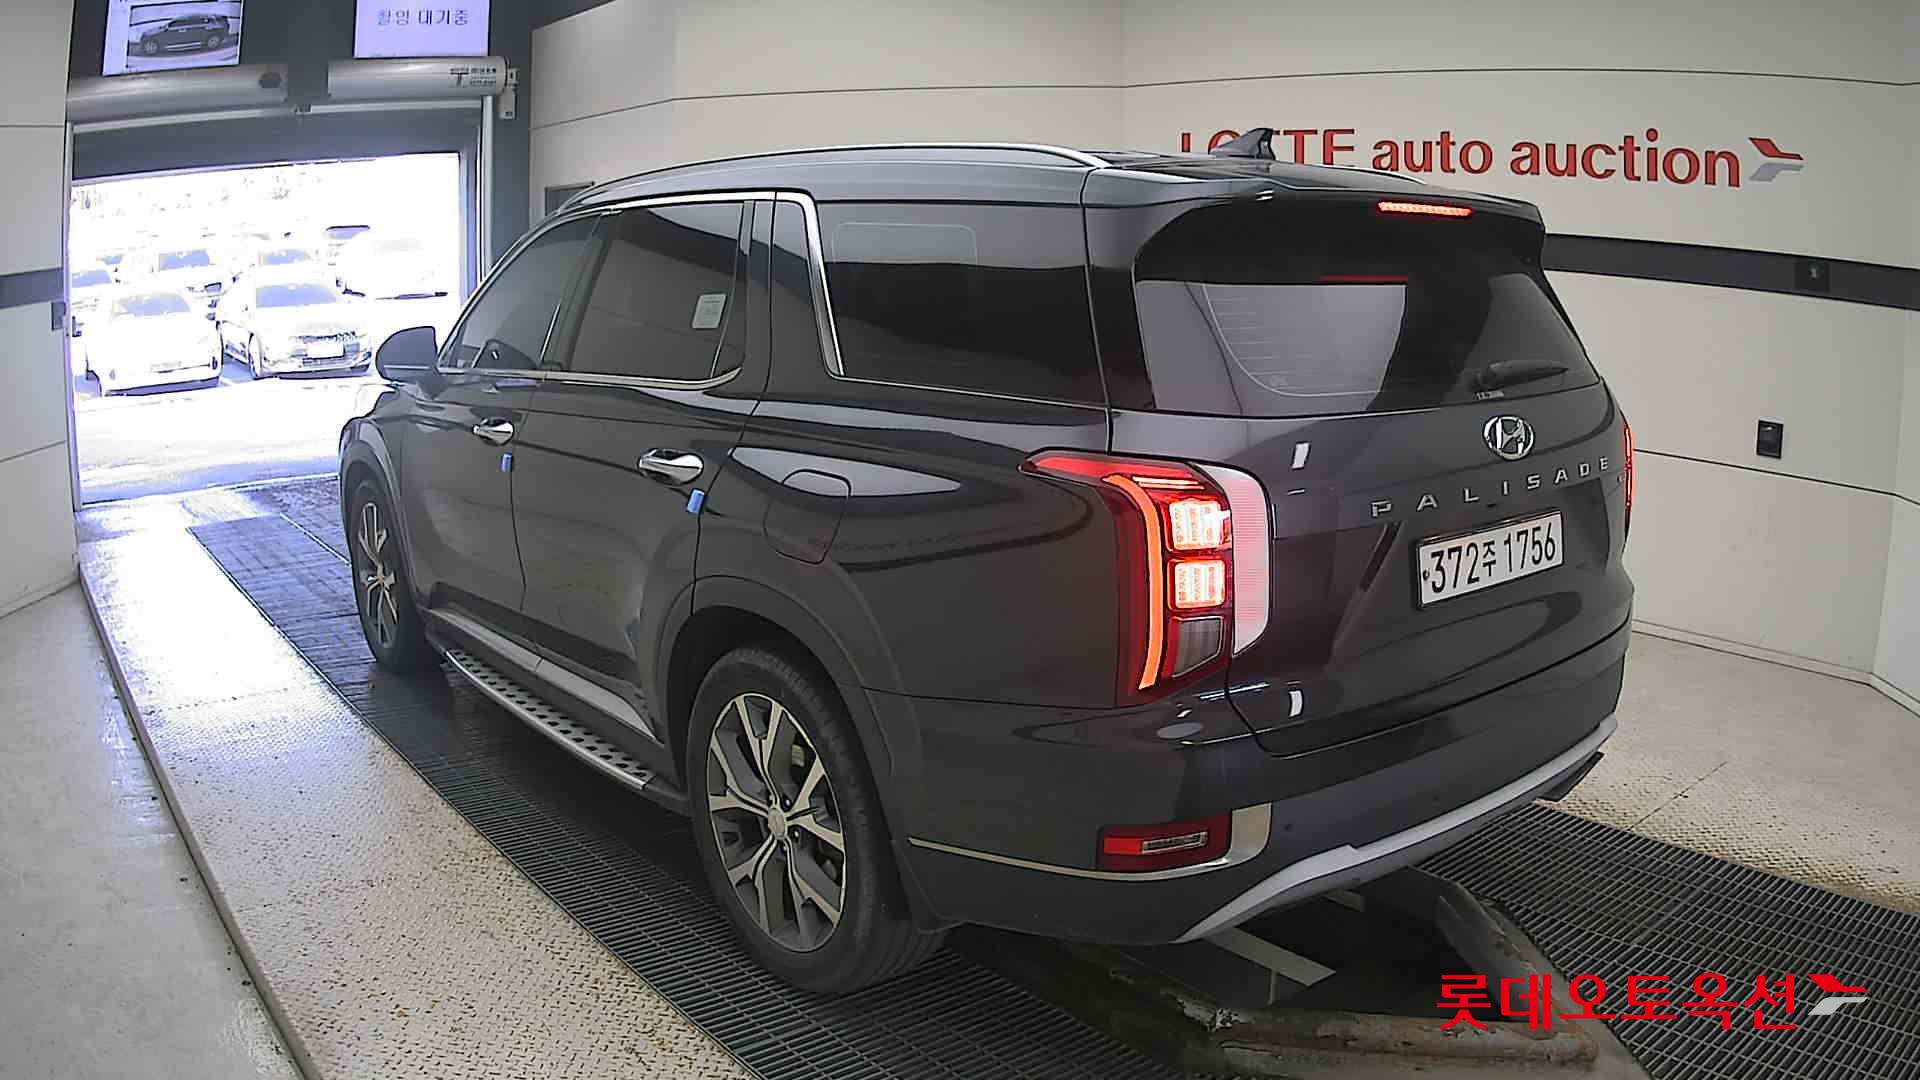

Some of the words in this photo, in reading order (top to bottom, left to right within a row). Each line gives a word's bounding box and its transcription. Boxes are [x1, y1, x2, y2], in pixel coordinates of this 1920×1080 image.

[418, 9, 469, 26] 대기중
[1371, 131, 1494, 174] auto
[1510, 128, 1741, 187] auction
[1371, 456, 1609, 518] PALISADE
